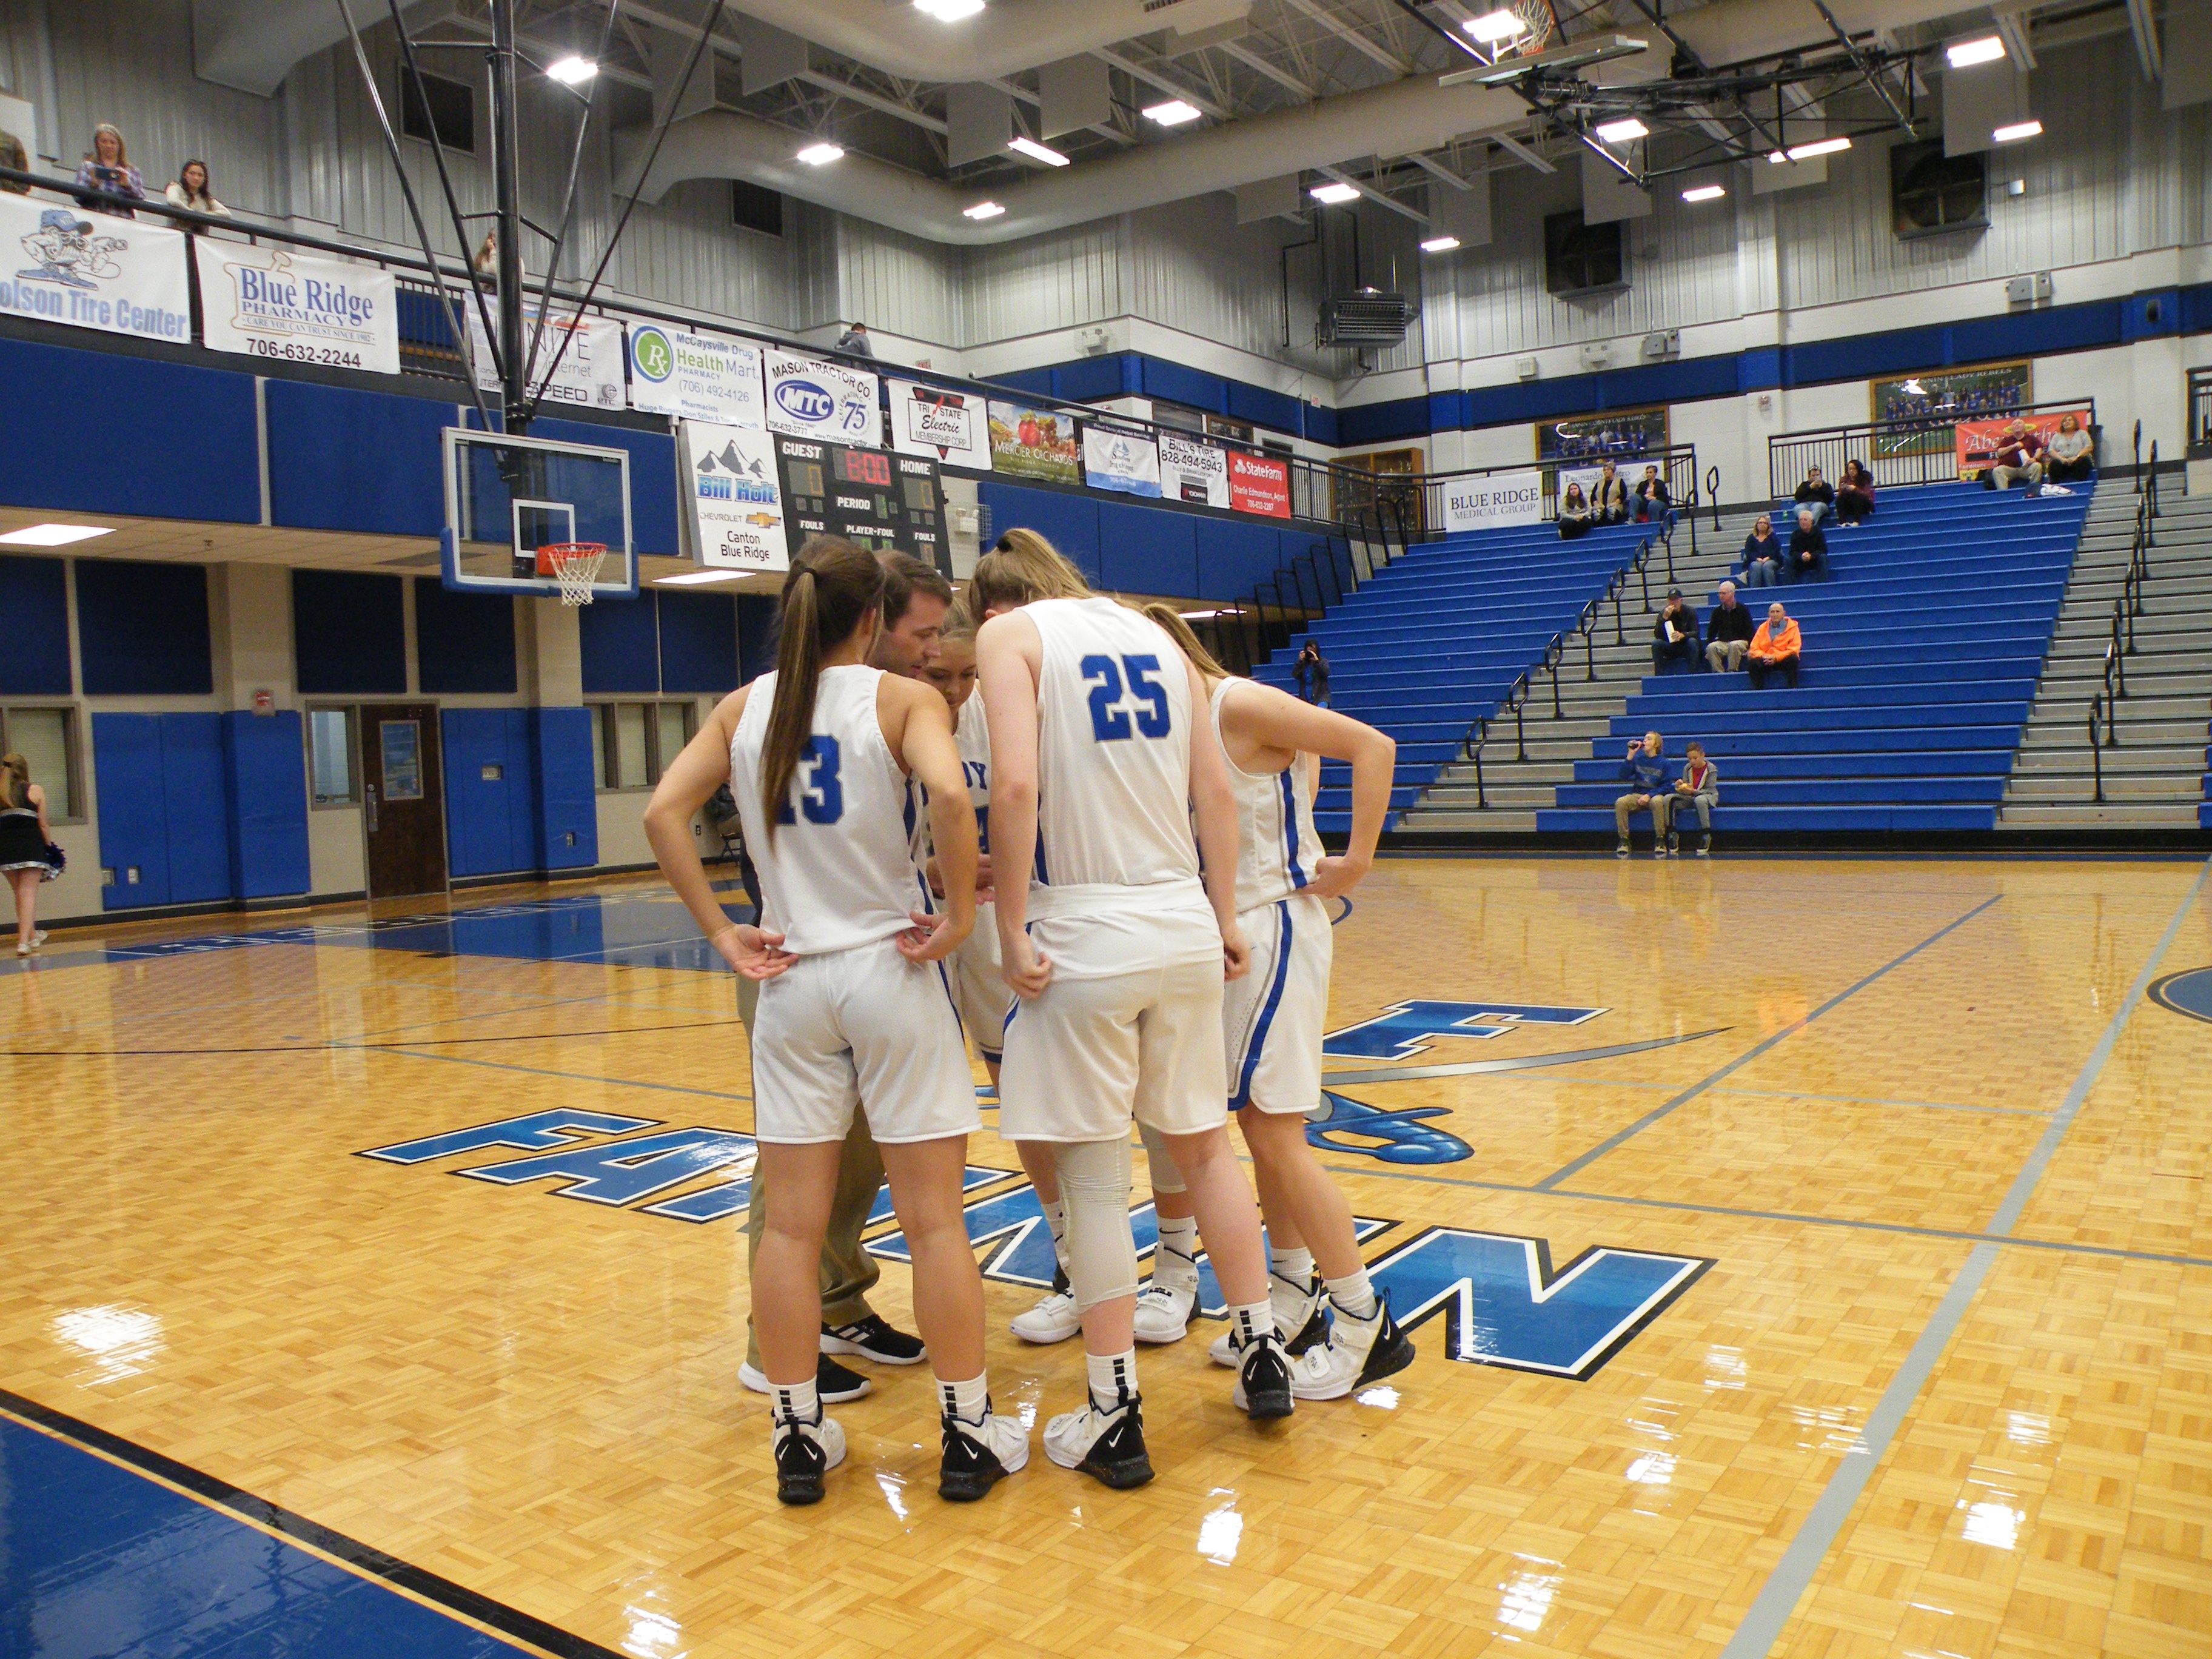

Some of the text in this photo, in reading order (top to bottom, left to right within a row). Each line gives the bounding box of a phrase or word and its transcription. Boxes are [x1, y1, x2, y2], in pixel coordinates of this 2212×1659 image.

[240, 267, 374, 327] Blue Ridge
[68, 289, 111, 326] Tire
[116, 299, 187, 338] Center
[243, 301, 346, 327] PHARMACY
[247, 317, 269, 327] CARE
[271, 320, 287, 330] YOU
[289, 323, 306, 332] CAN
[308, 325, 332, 336] TRUST
[334, 329, 355, 340] SINCE
[247, 338, 362, 368] 706-632-2244
[676, 333, 753, 361] McCaysville Drug
[677, 349, 757, 379] Health Mart
[678, 366, 720, 380] PHARMACY
[772, 361, 871, 400] MASON TRACTOR CO.
[679, 380, 749, 403] (706) 492-4126
[638, 403, 658, 414] Huge
[681, 399, 719, 412] Pharmacists
[783, 387, 831, 415] MTC
[843, 401, 866, 430] 75
[917, 403, 962, 420] TRI STATE
[768, 420, 808, 435] 706-632-3777
[921, 414, 960, 434] Electric
[814, 433, 879, 449] www.masontractor.com
[915, 431, 951, 444] MEMBERSHIP
[782, 441, 822, 459] GUEST
[994, 440, 1031, 458] MERCIER
[1197, 445, 1215, 459] TIRE
[900, 459, 931, 475] HOME
[1161, 449, 1222, 472] 828-494-5943
[1565, 472, 1603, 483] Leonardo
[697, 474, 779, 506] Bill Holt
[1450, 488, 1538, 510] BLUE RIDGE
[837, 495, 871, 511] PERIOD
[1455, 503, 1536, 520] MEDICAL GROUP
[699, 512, 743, 523] CHEVROLET
[800, 520, 825, 531] FOULS
[727, 531, 760, 545] Canton
[914, 532, 936, 542] FOULS
[720, 544, 770, 561] Blue Ridge
[1080, 653, 1171, 742] 25
